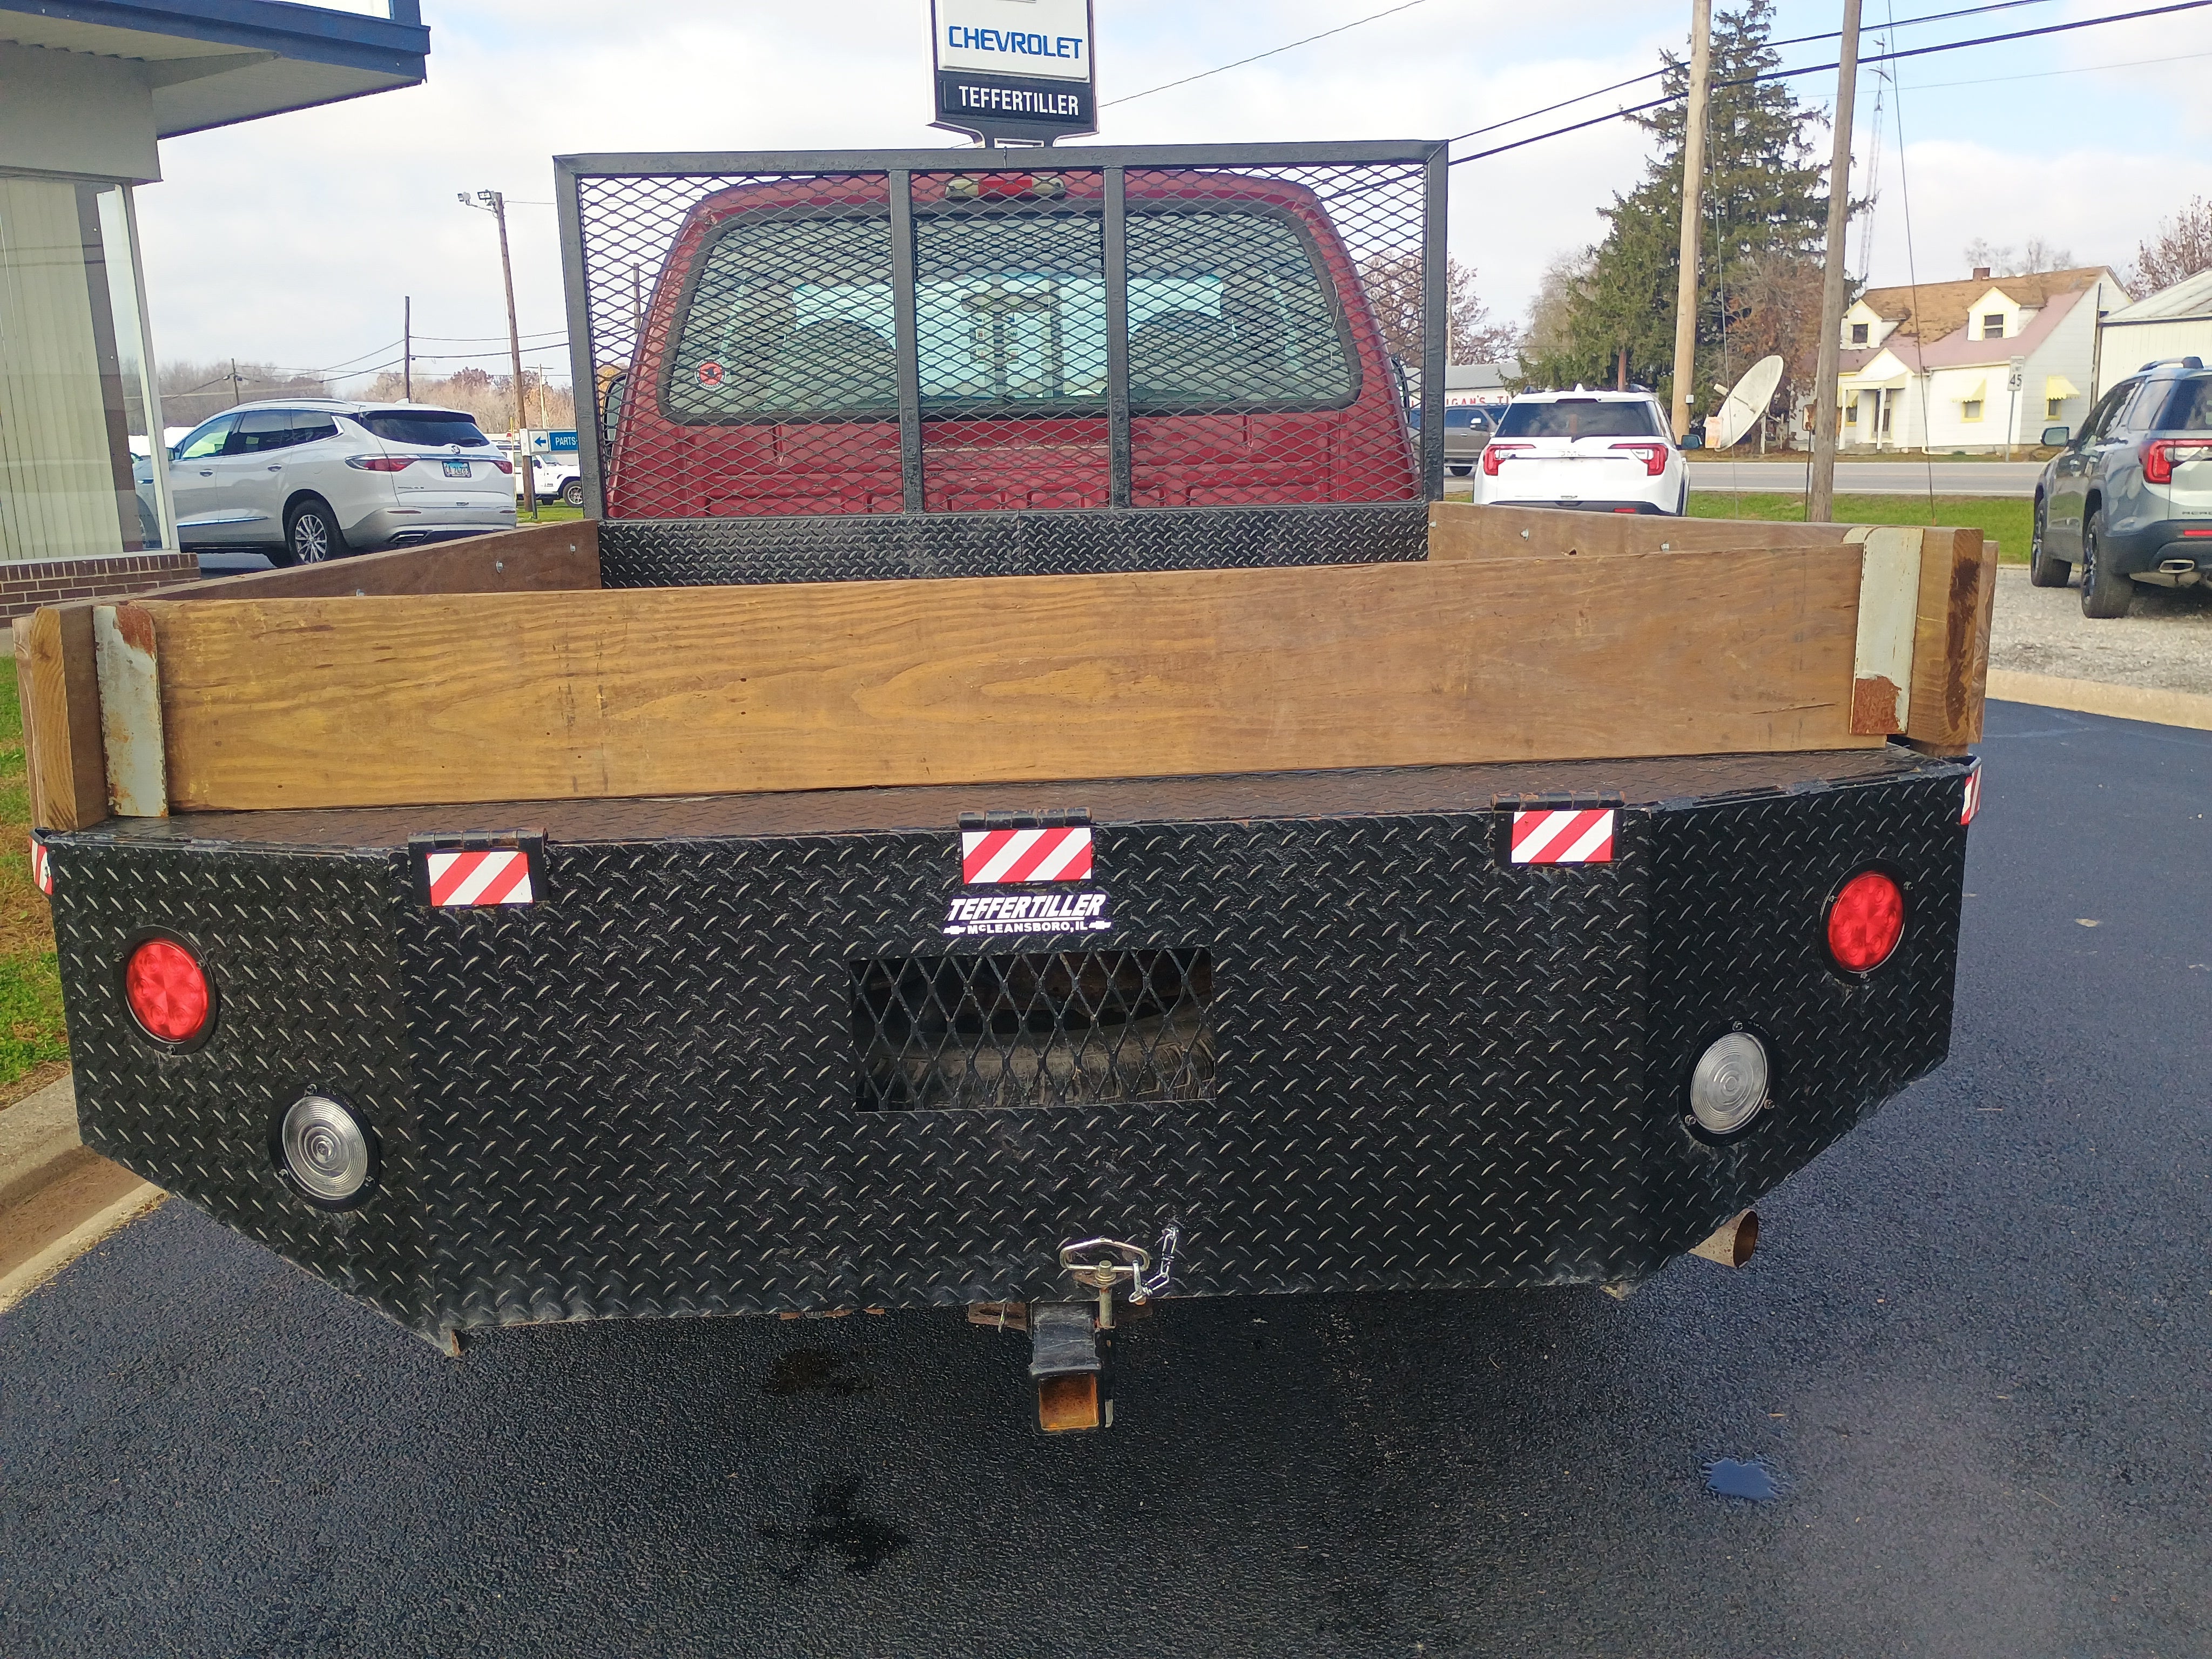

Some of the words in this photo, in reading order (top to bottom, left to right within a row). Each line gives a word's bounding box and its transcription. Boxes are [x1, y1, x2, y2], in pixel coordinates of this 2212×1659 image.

[949, 26, 1082, 58] CHEVROLET
[959, 86, 1078, 116] TEFFERTILLER
[2009, 374, 2022, 387] 45
[948, 894, 1105, 921] TEFFERTILLER
[1075, 921, 1088, 930] IL
